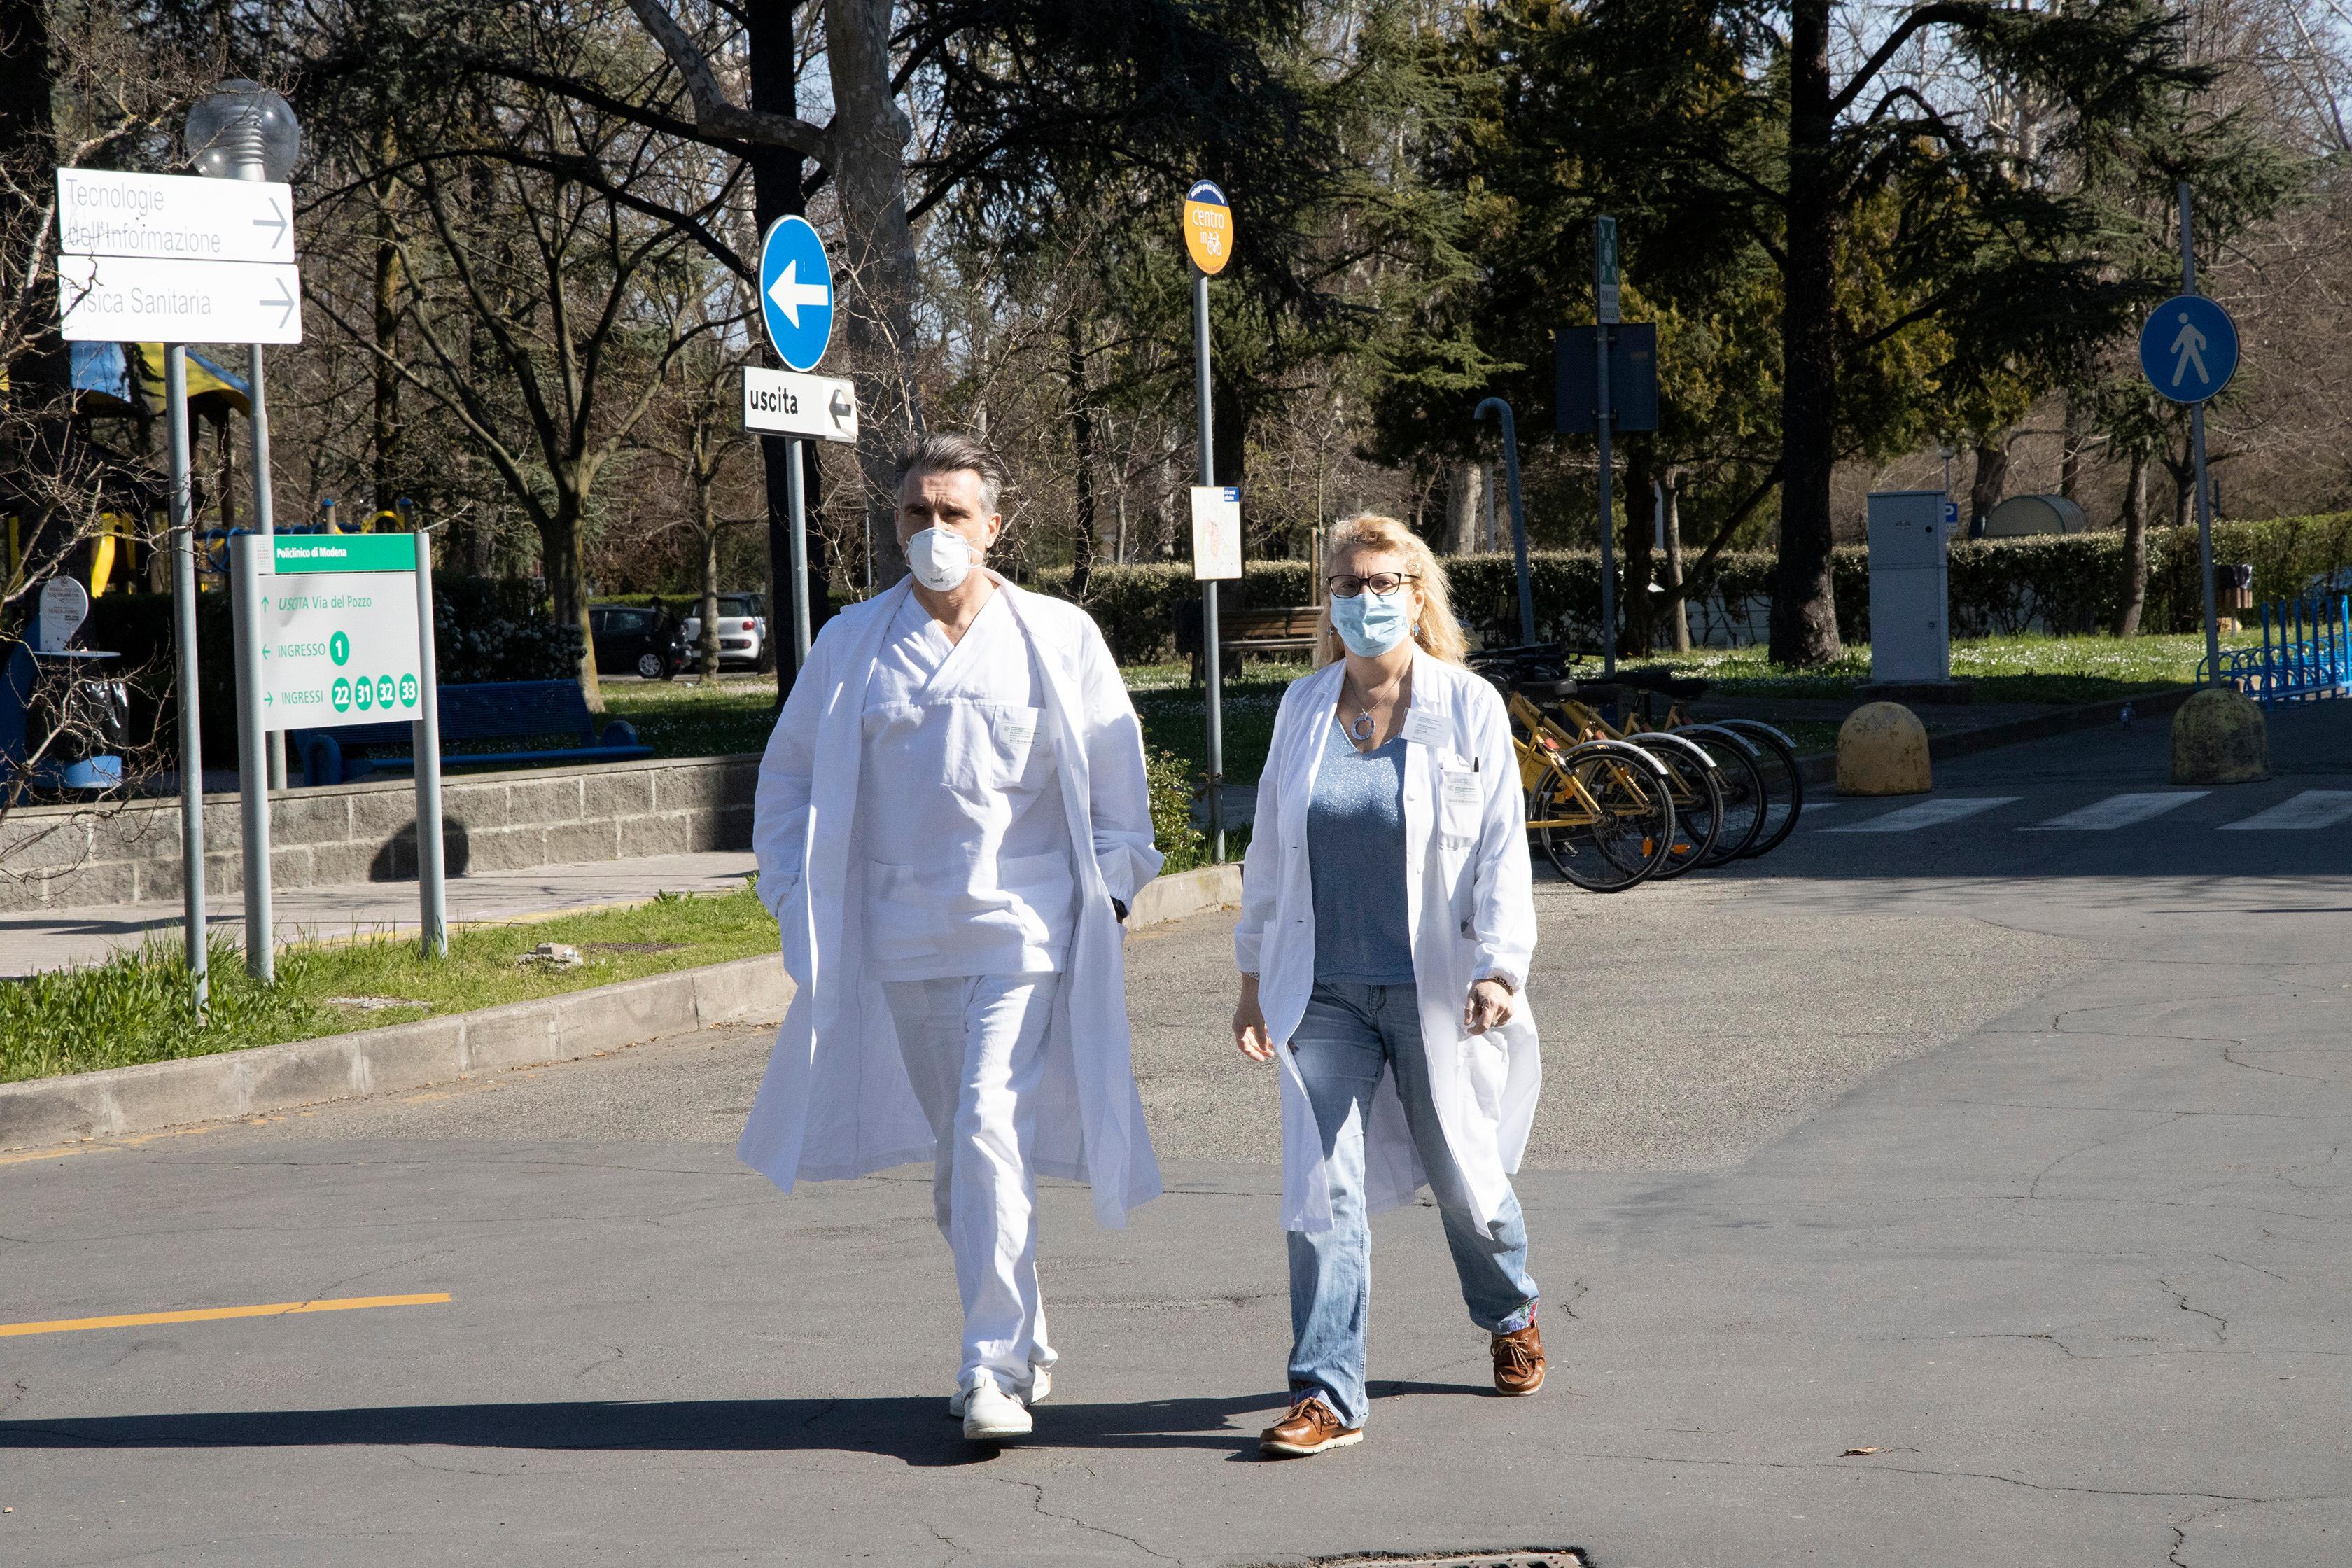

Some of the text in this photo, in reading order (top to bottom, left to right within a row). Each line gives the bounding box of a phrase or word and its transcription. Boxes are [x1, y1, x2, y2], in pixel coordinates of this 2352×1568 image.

[66, 178, 164, 216] Tecnologie
[1200, 227, 1208, 244] in
[131, 287, 211, 314] Sanitaria
[750, 386, 798, 415] uscita
[276, 546, 347, 559] Policlinico di Modena
[279, 595, 372, 611] USCITA Via del Pozzo
[278, 640, 342, 657] INGRESSO 1
[281, 682, 416, 704] INGRESSI 22 31 32 33
